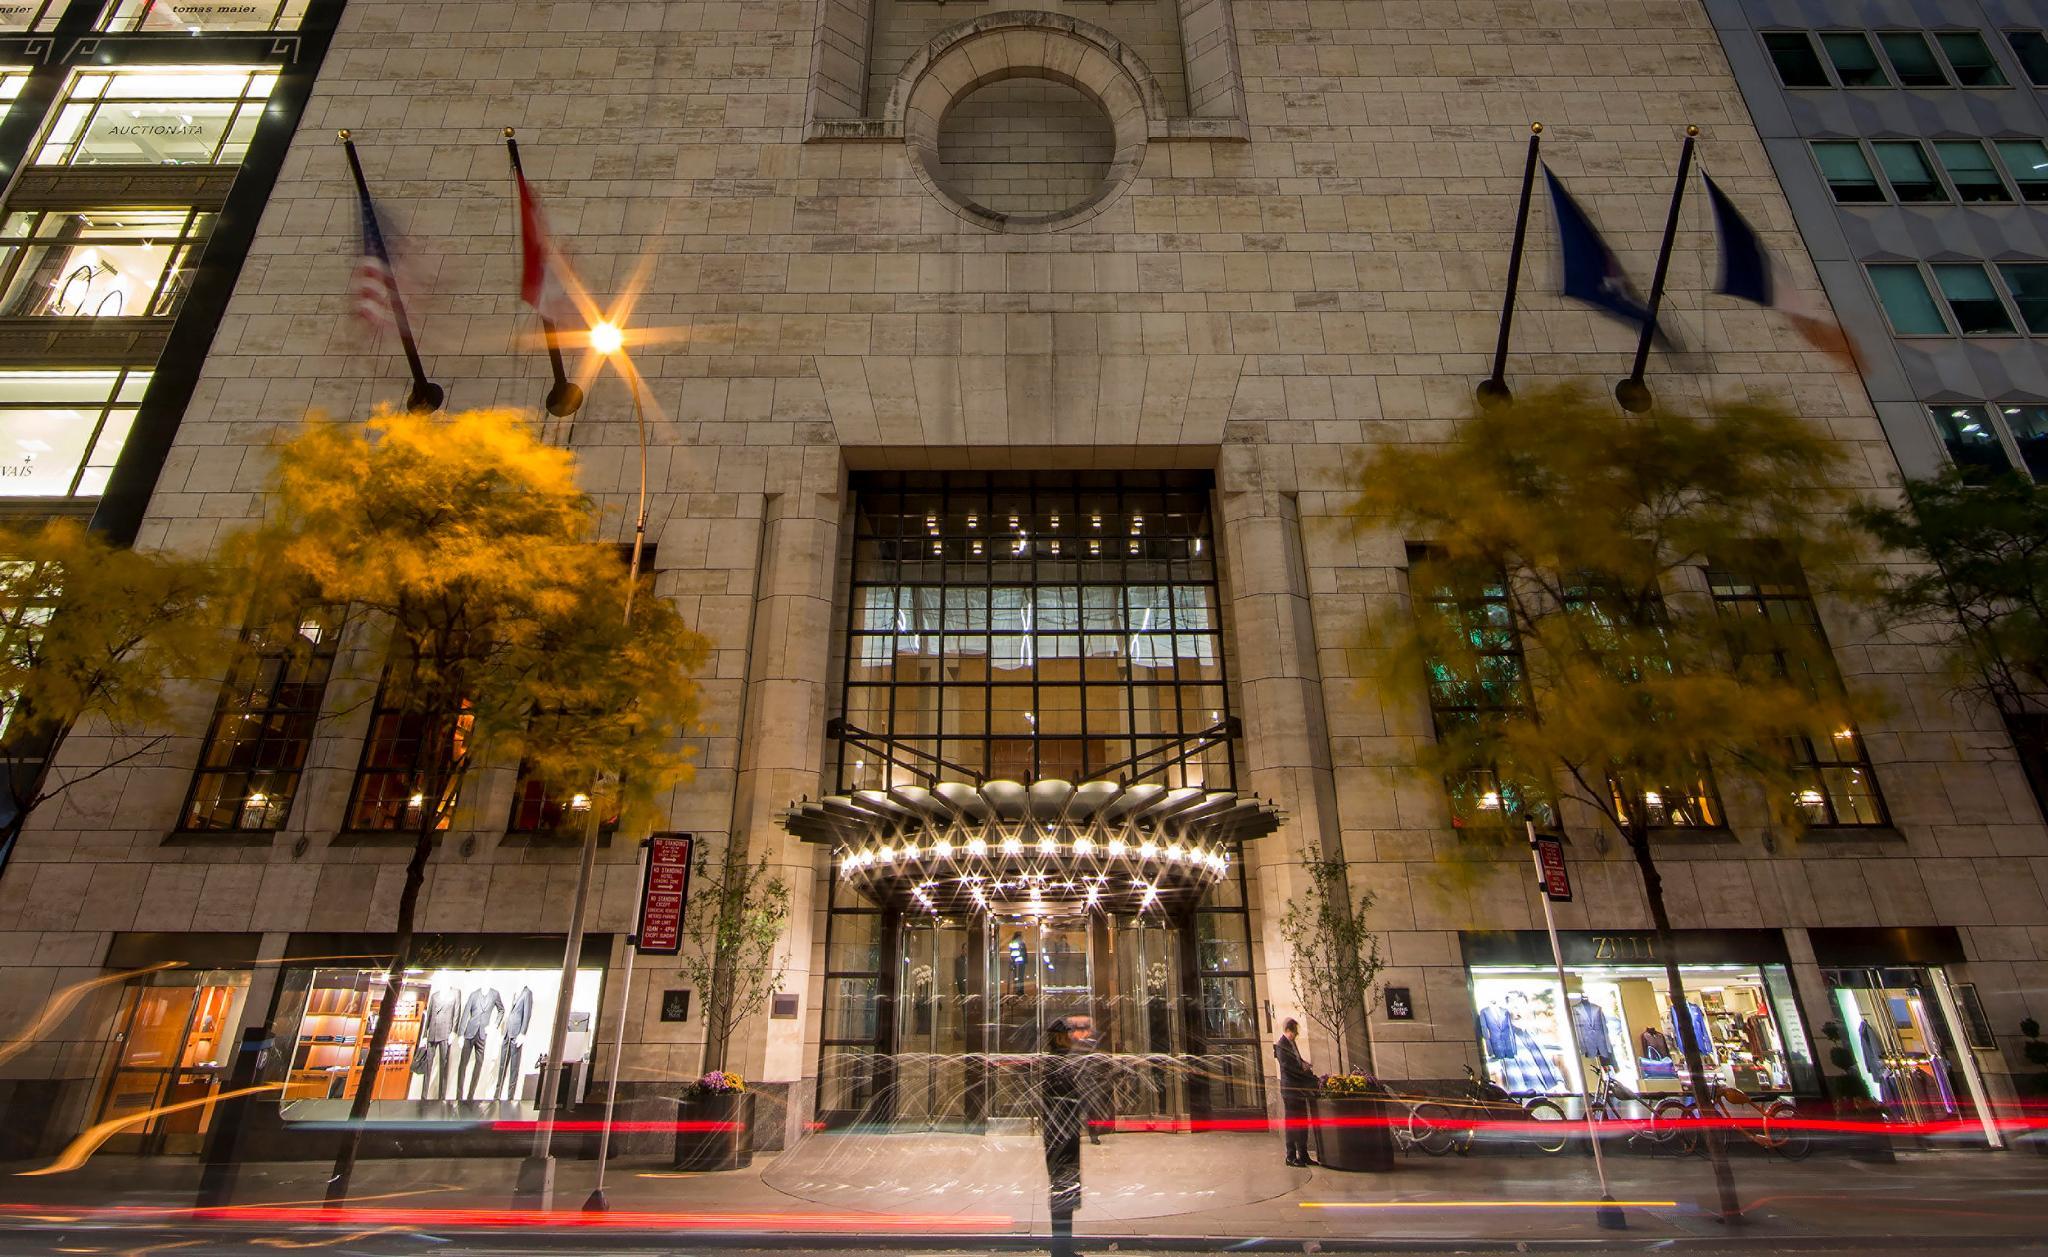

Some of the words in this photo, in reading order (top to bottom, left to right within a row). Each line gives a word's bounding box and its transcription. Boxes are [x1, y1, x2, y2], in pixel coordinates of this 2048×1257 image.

[172, 5, 211, 13] tomas
[217, 5, 256, 13] maier
[108, 125, 203, 135] AUCTIONATA
[1592, 936, 1656, 960] ZILLI
